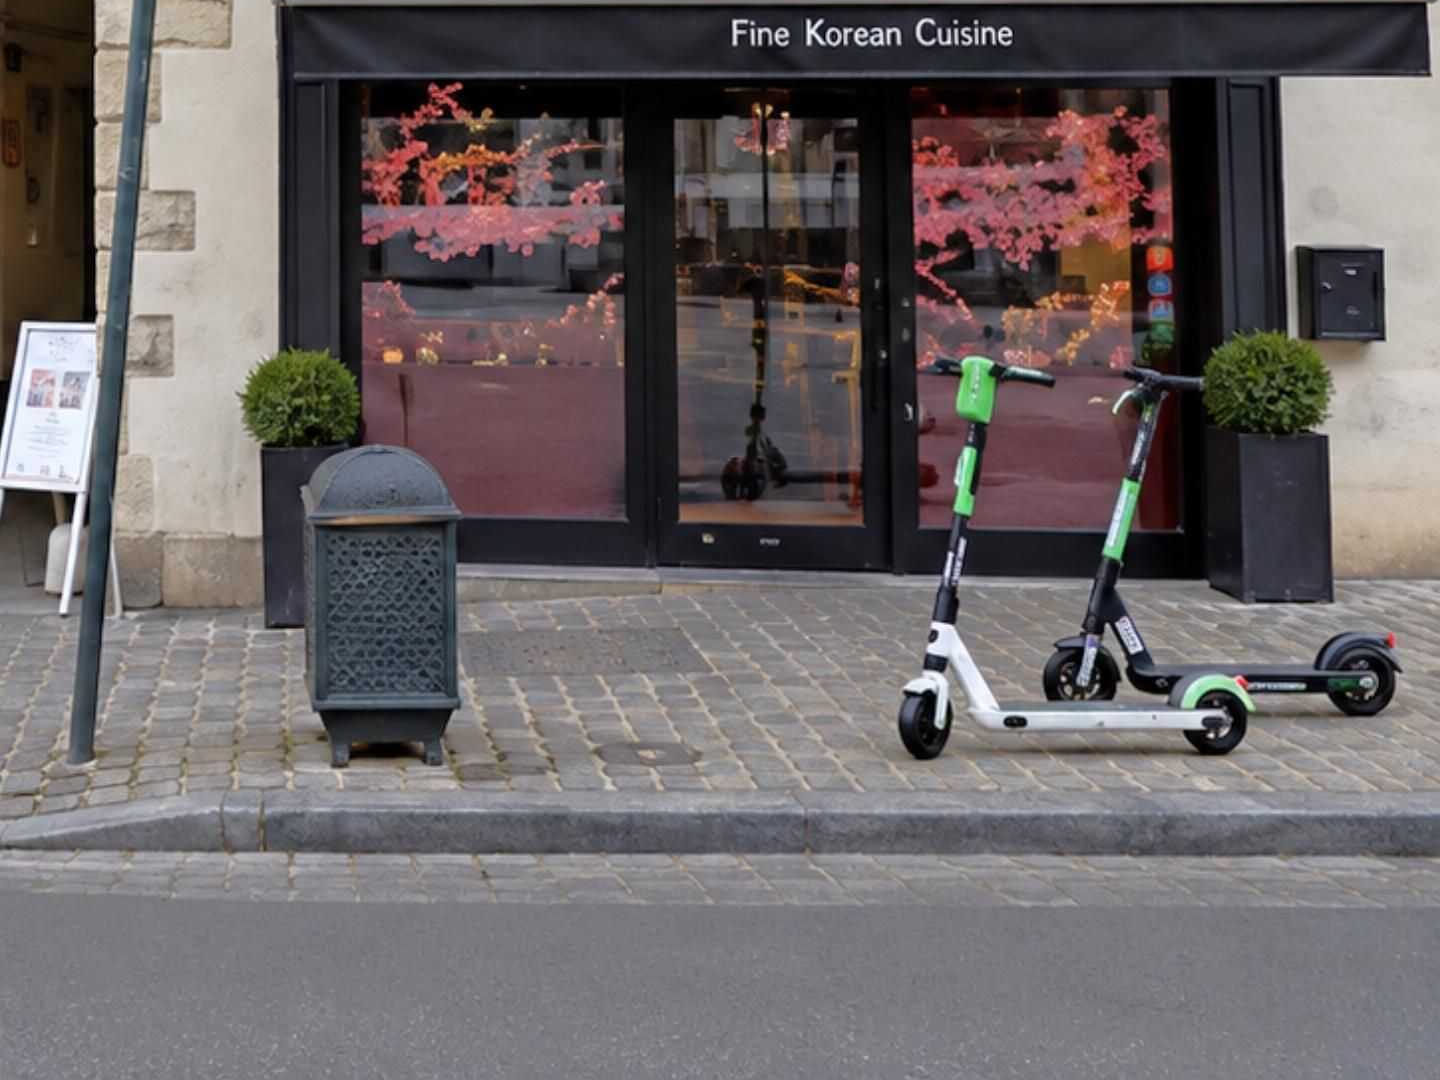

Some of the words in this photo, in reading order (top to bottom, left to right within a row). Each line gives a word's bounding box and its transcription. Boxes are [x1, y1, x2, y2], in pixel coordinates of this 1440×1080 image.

[730, 18, 790, 48] Fine
[804, 18, 902, 48] Korean
[914, 18, 1014, 48] Cuisine
